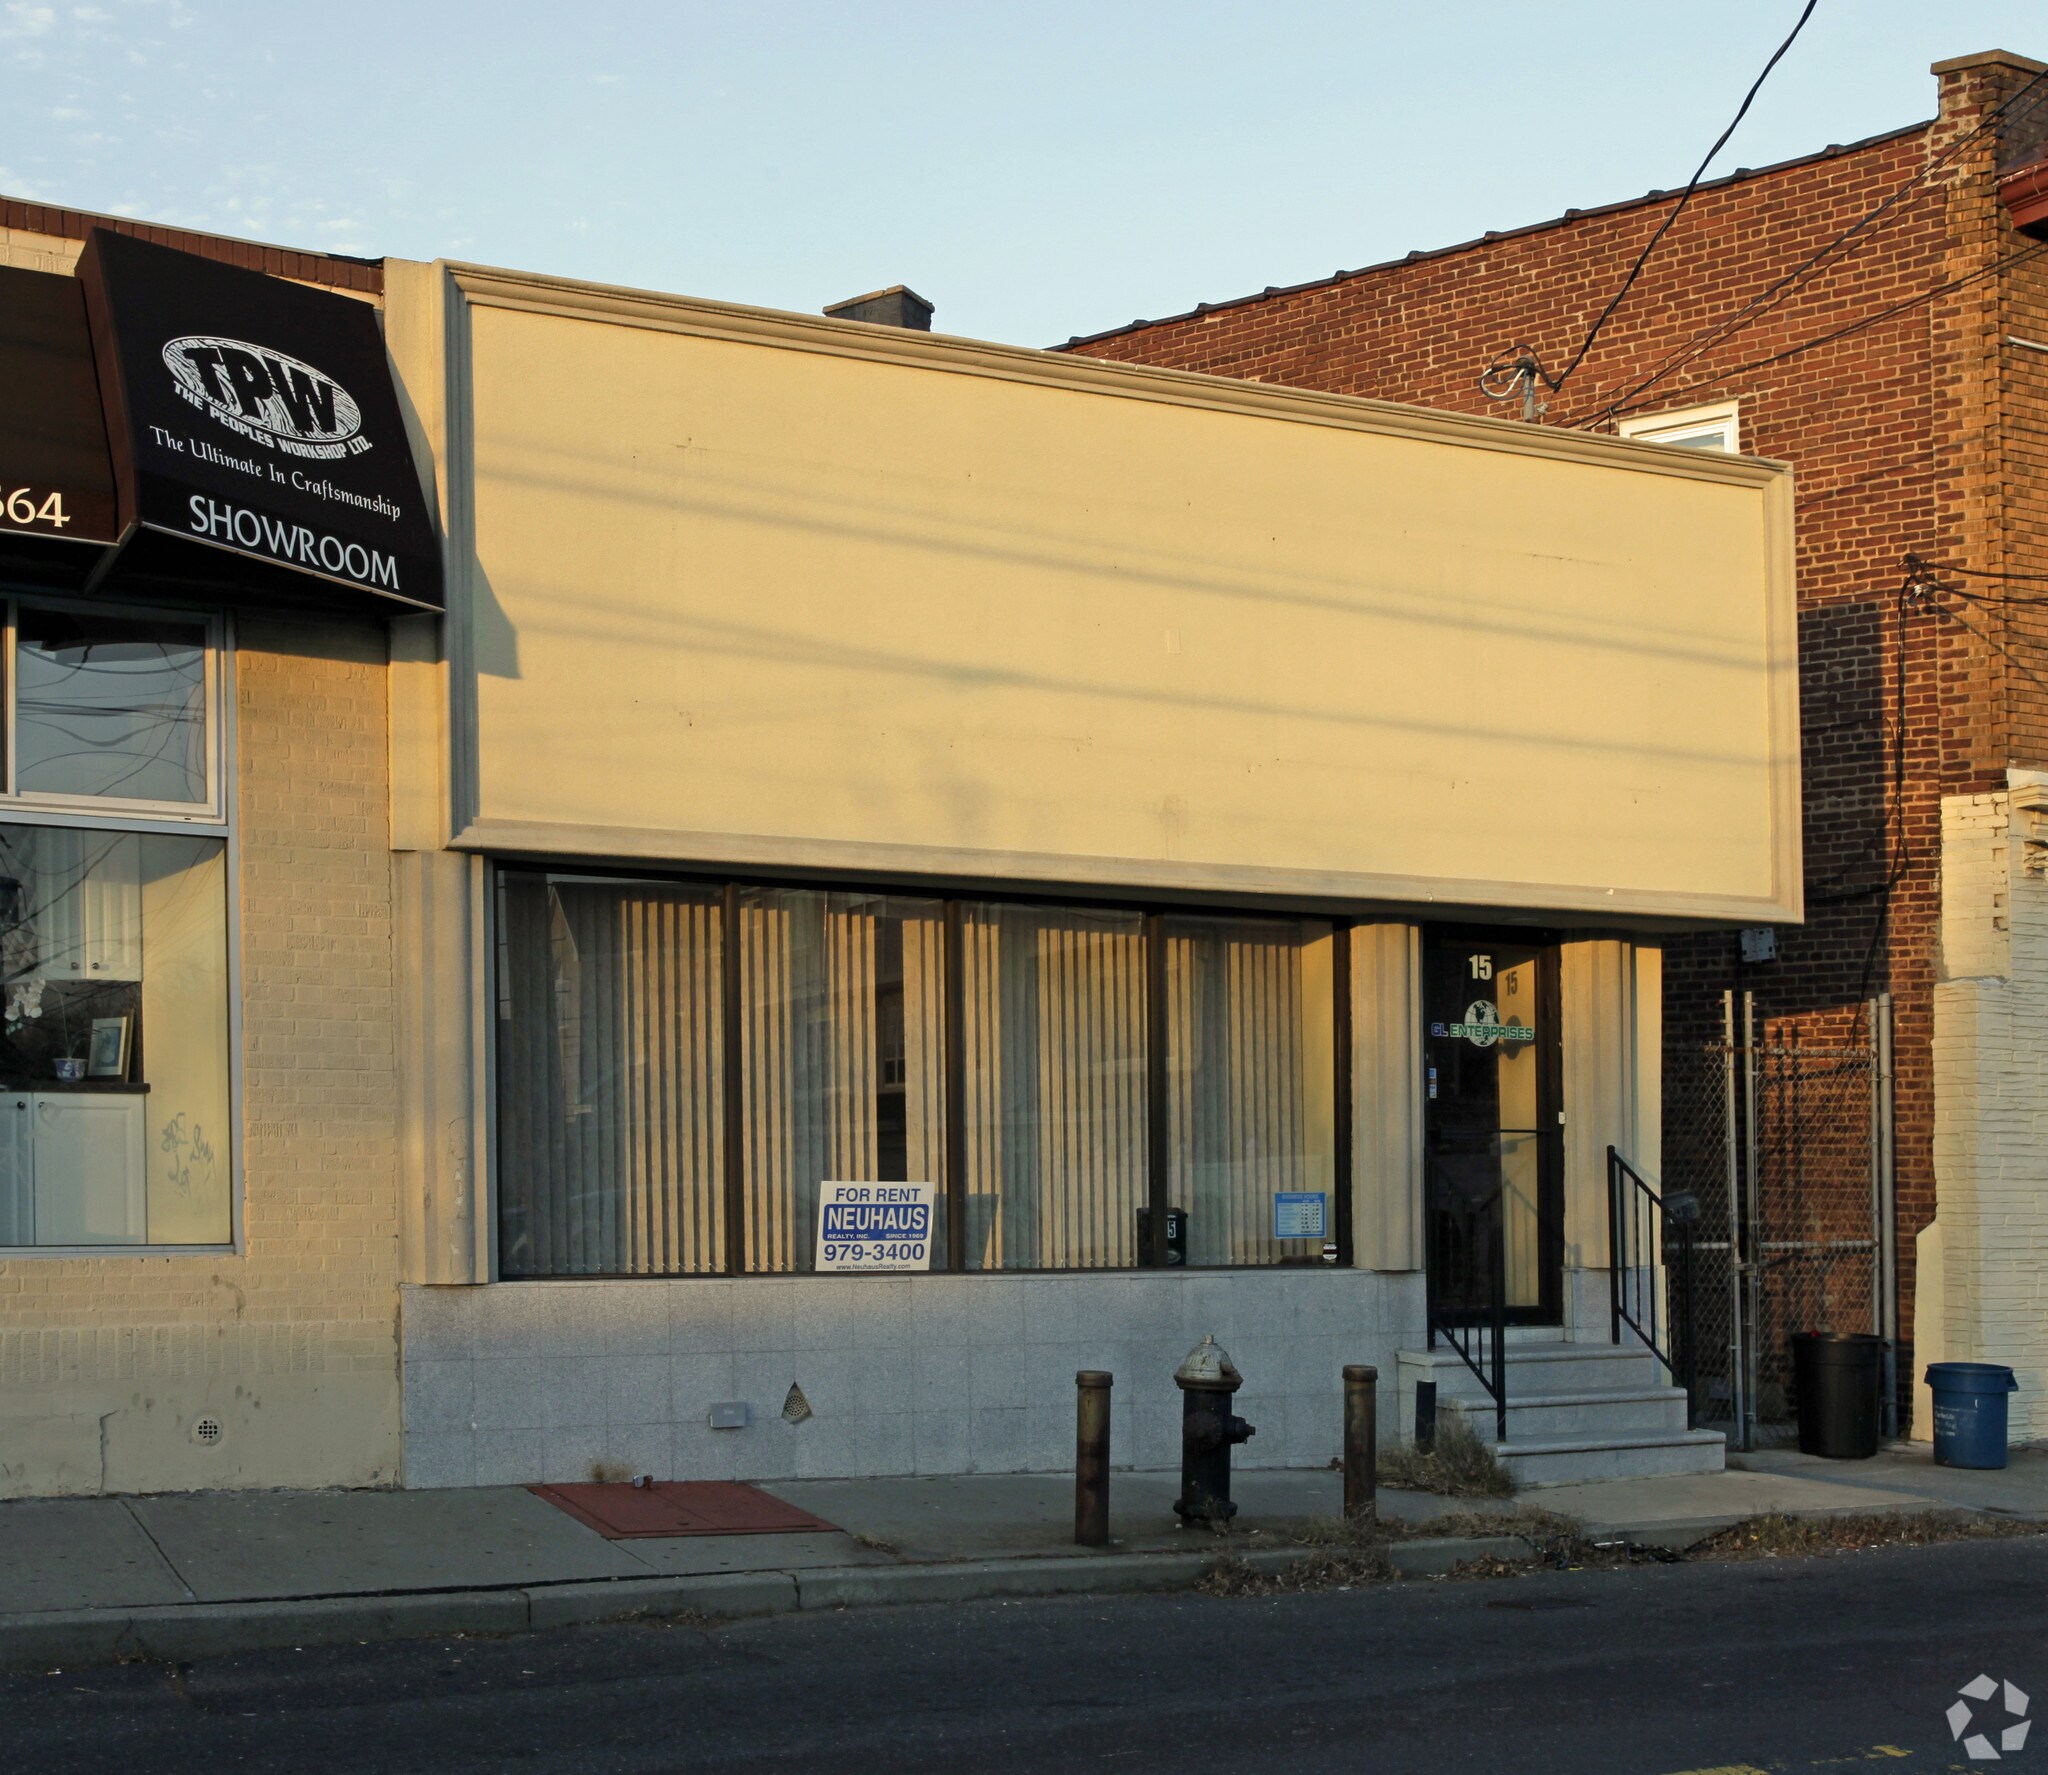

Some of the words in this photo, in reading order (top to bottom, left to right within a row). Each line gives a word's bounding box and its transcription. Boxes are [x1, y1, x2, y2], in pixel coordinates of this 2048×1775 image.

[183, 346, 338, 434] TPW
[173, 379, 204, 411] THE
[209, 405, 275, 449] PEOPLES
[276, 437, 347, 460] WORKSHOP
[346, 434, 373, 456] LTD.
[149, 425, 185, 454] The
[190, 439, 262, 478] Ultimate
[269, 463, 287, 485] In
[291, 470, 402, 522] Craftsmanship
[188, 494, 401, 591] SHOWROOM
[1468, 954, 1493, 981] 15
[1431, 1022, 1449, 1037] GL
[1449, 1024, 1534, 1041] ENTERPRISES
[835, 1187, 871, 1203] FOR
[876, 1188, 921, 1202] RENT
[827, 1206, 926, 1231] NEUHAUS
[823, 1243, 925, 1262] 979-3400
[836, 1263, 911, 1271] www.NeuhausRealty.com
